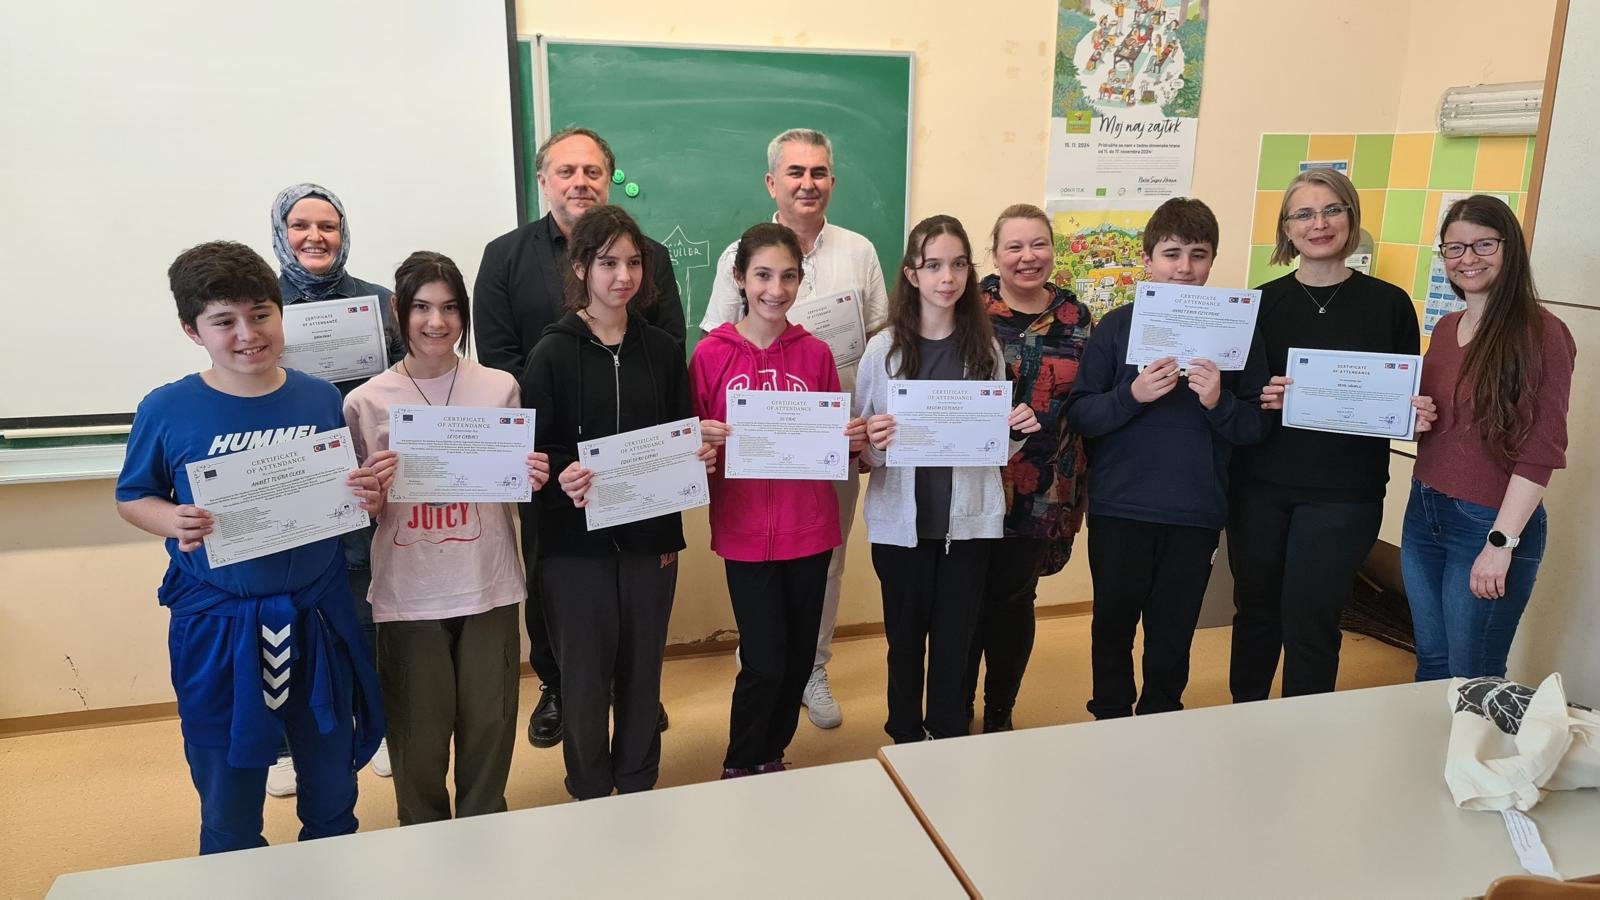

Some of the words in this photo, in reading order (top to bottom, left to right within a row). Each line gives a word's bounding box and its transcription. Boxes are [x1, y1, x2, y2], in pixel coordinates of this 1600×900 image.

[1099, 114, 1124, 139] Moj
[1125, 121, 1145, 139] naj
[1147, 117, 1182, 139] zajtrk
[1180, 293, 1217, 301] CERTIFICATE
[208, 426, 317, 455] HUMMEL
[624, 435, 659, 447] CERTIFICATE
[629, 440, 665, 452] ATTENDANCE
[251, 452, 297, 466] CERTIFICATE
[258, 456, 306, 472] ATTENDANCE
[408, 503, 469, 529] JUICY
